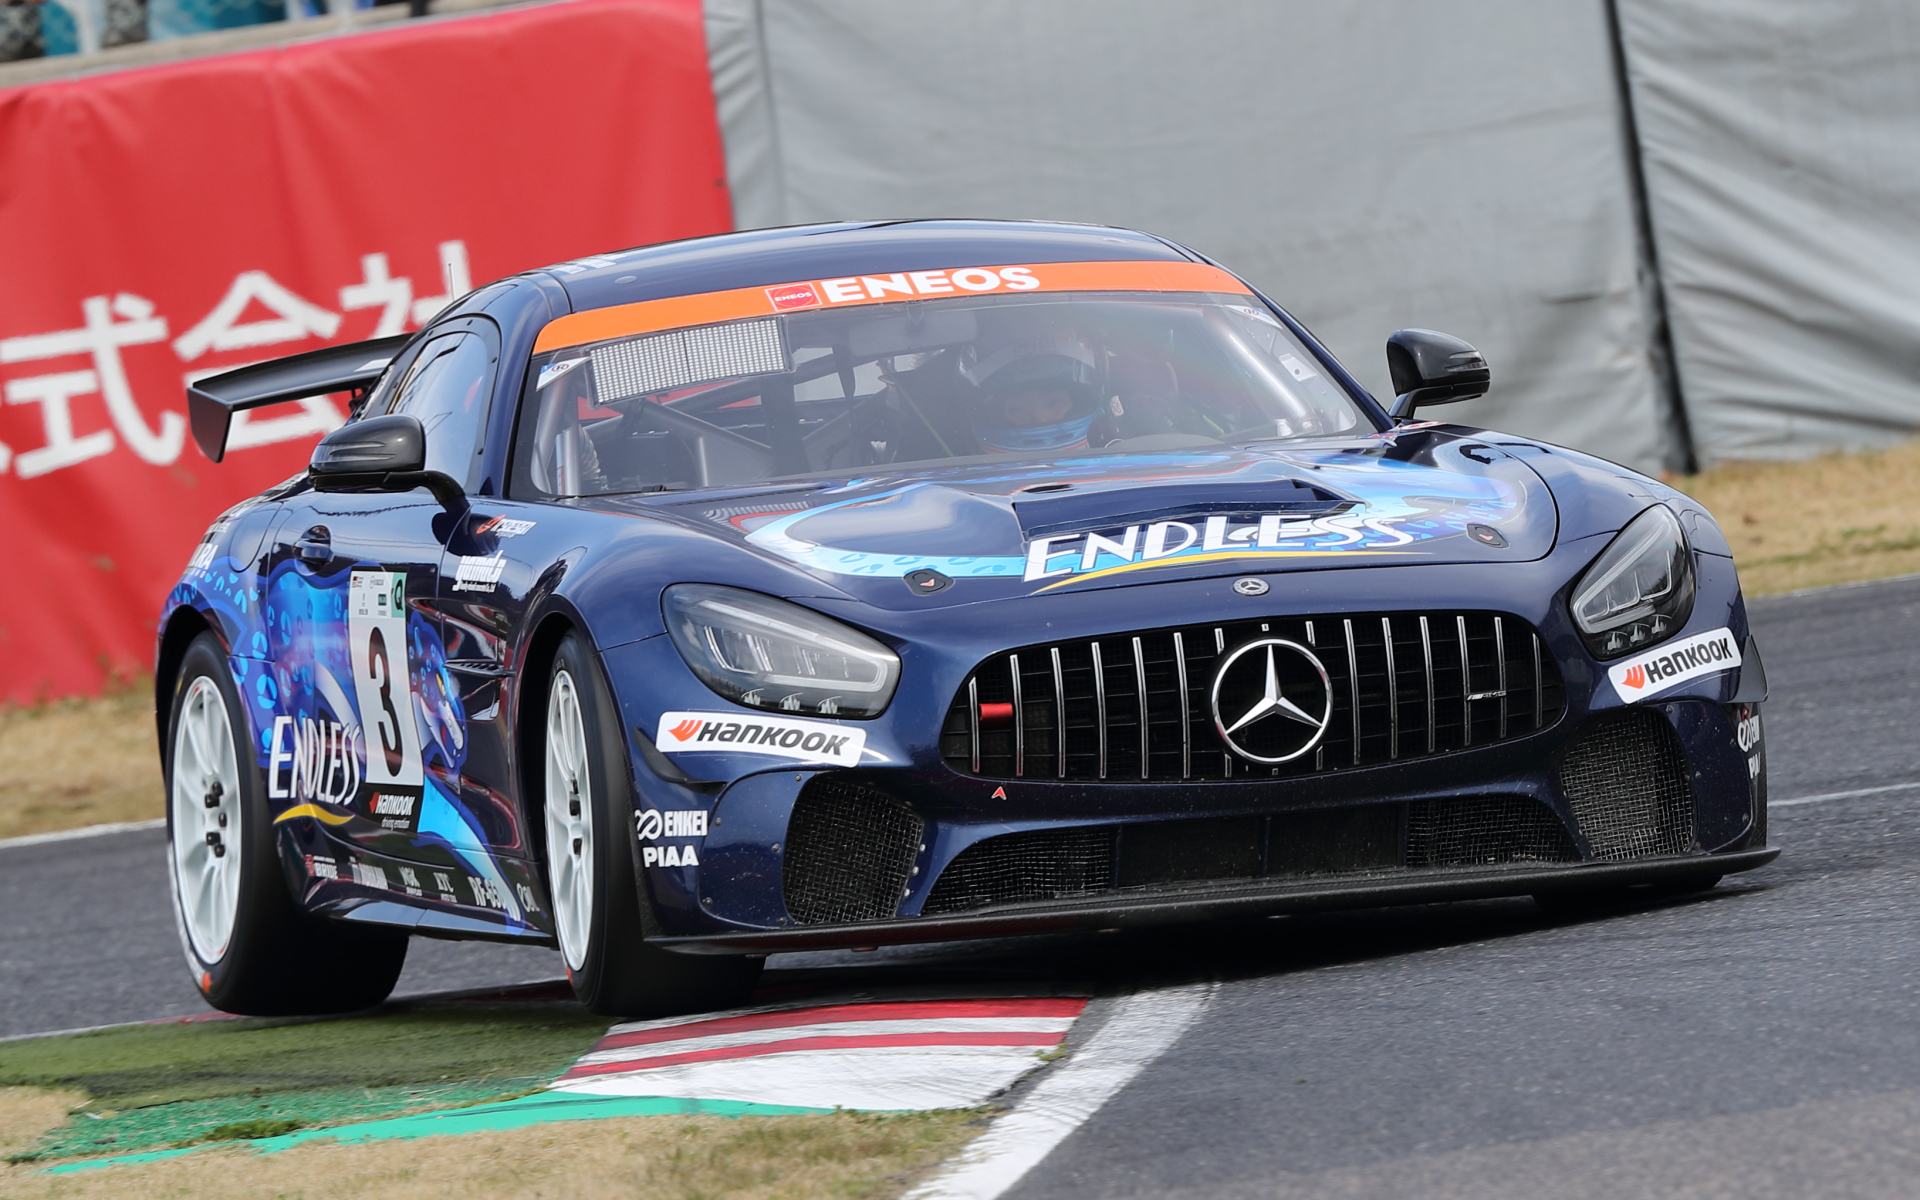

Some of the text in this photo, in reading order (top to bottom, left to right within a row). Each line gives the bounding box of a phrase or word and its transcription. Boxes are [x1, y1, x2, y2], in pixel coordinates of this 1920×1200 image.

[820, 267, 1040, 303] ENEOS
[1022, 513, 1416, 583] ENDLESS
[369, 626, 403, 777] 3
[268, 715, 361, 806] ENDLESS
[664, 810, 709, 837] ENKEI
[314, 862, 339, 880] BRIDE
[643, 845, 699, 867] PIAA
